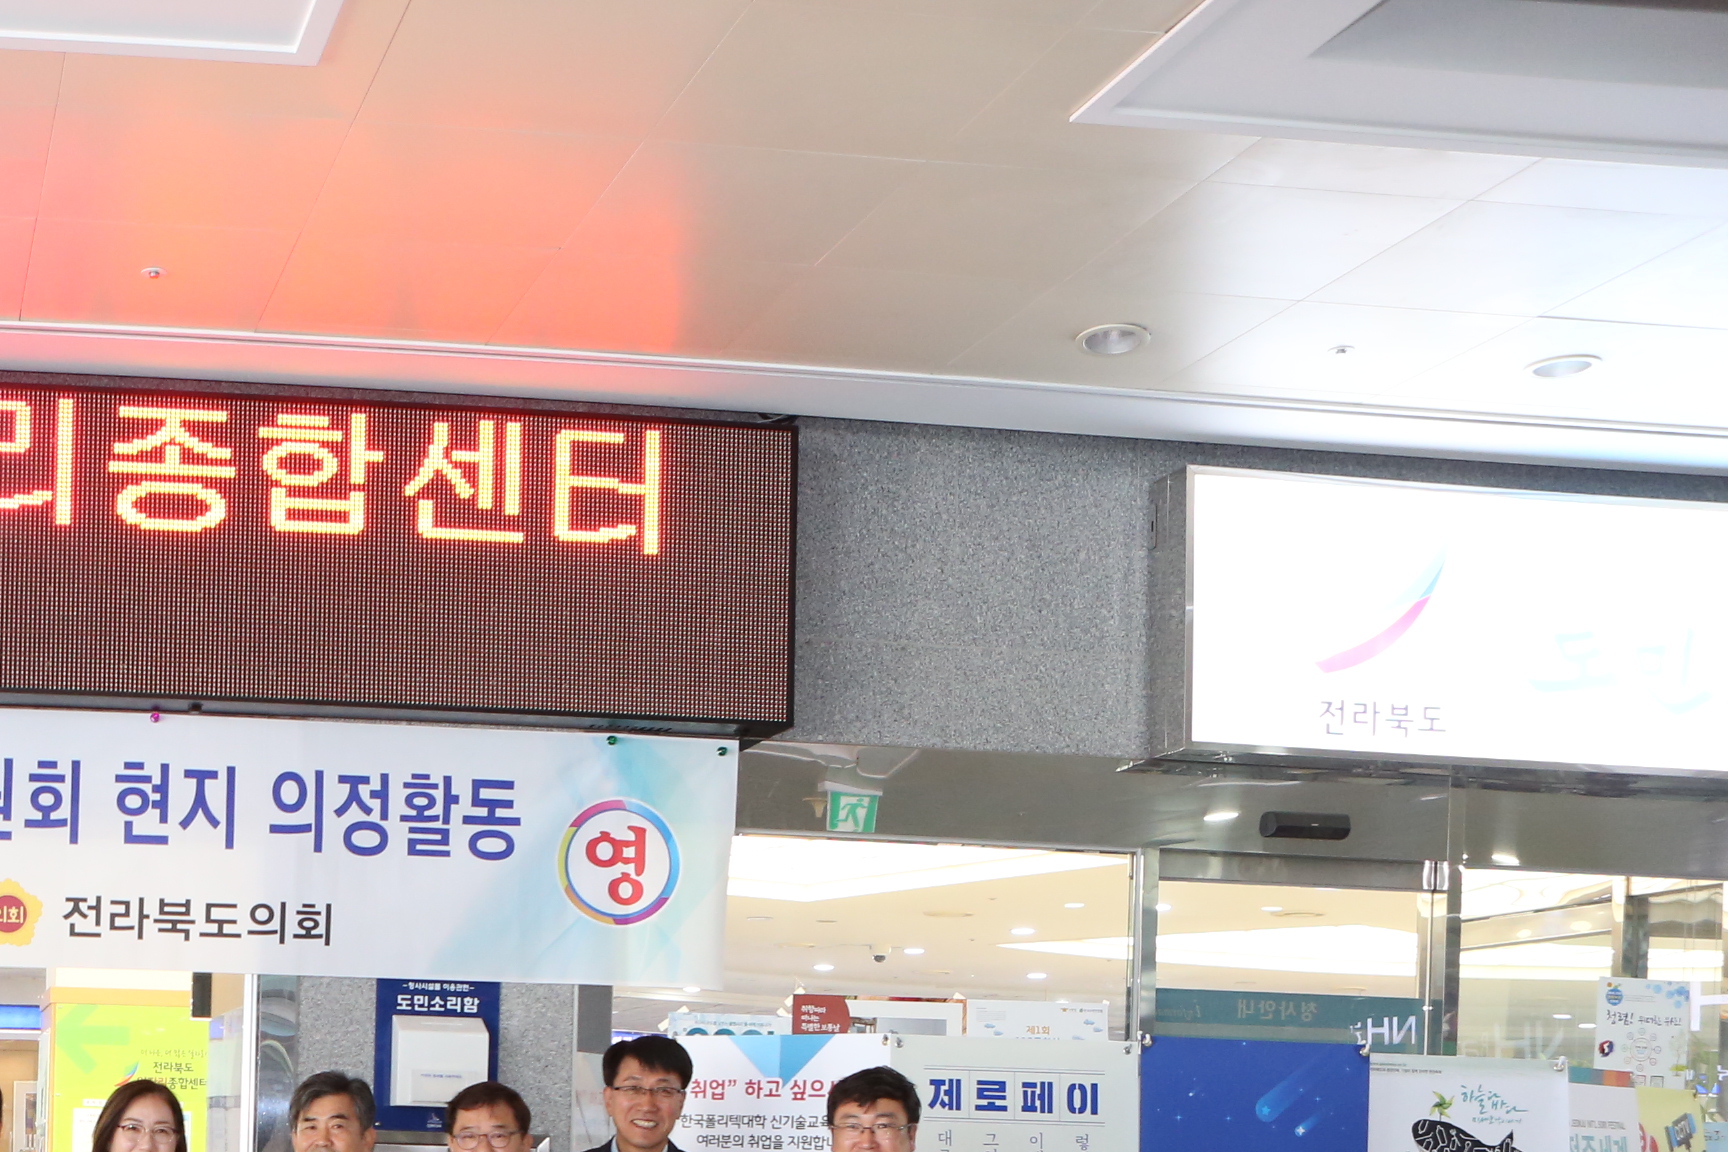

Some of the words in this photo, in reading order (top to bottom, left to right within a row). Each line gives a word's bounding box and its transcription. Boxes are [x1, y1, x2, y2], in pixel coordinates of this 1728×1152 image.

[1318, 700, 1448, 738] 전라북도
[115, 761, 237, 848] 현지
[270, 769, 522, 860] 의정활동
[585, 825, 648, 906] 영
[63, 894, 334, 947] 전라북도의회
[396, 994, 480, 1014] 도민소리함
[1026, 1025, 1050, 1036] 제1회
[152, 1061, 195, 1074] 전라북도
[744, 1079, 782, 1100] 하고
[927, 1078, 1099, 1116] 제로페이
[680, 1114, 766, 1130] 한국폴리텍대학
[696, 1134, 745, 1149] 여러분의
[747, 1136, 785, 1150] 취업을
